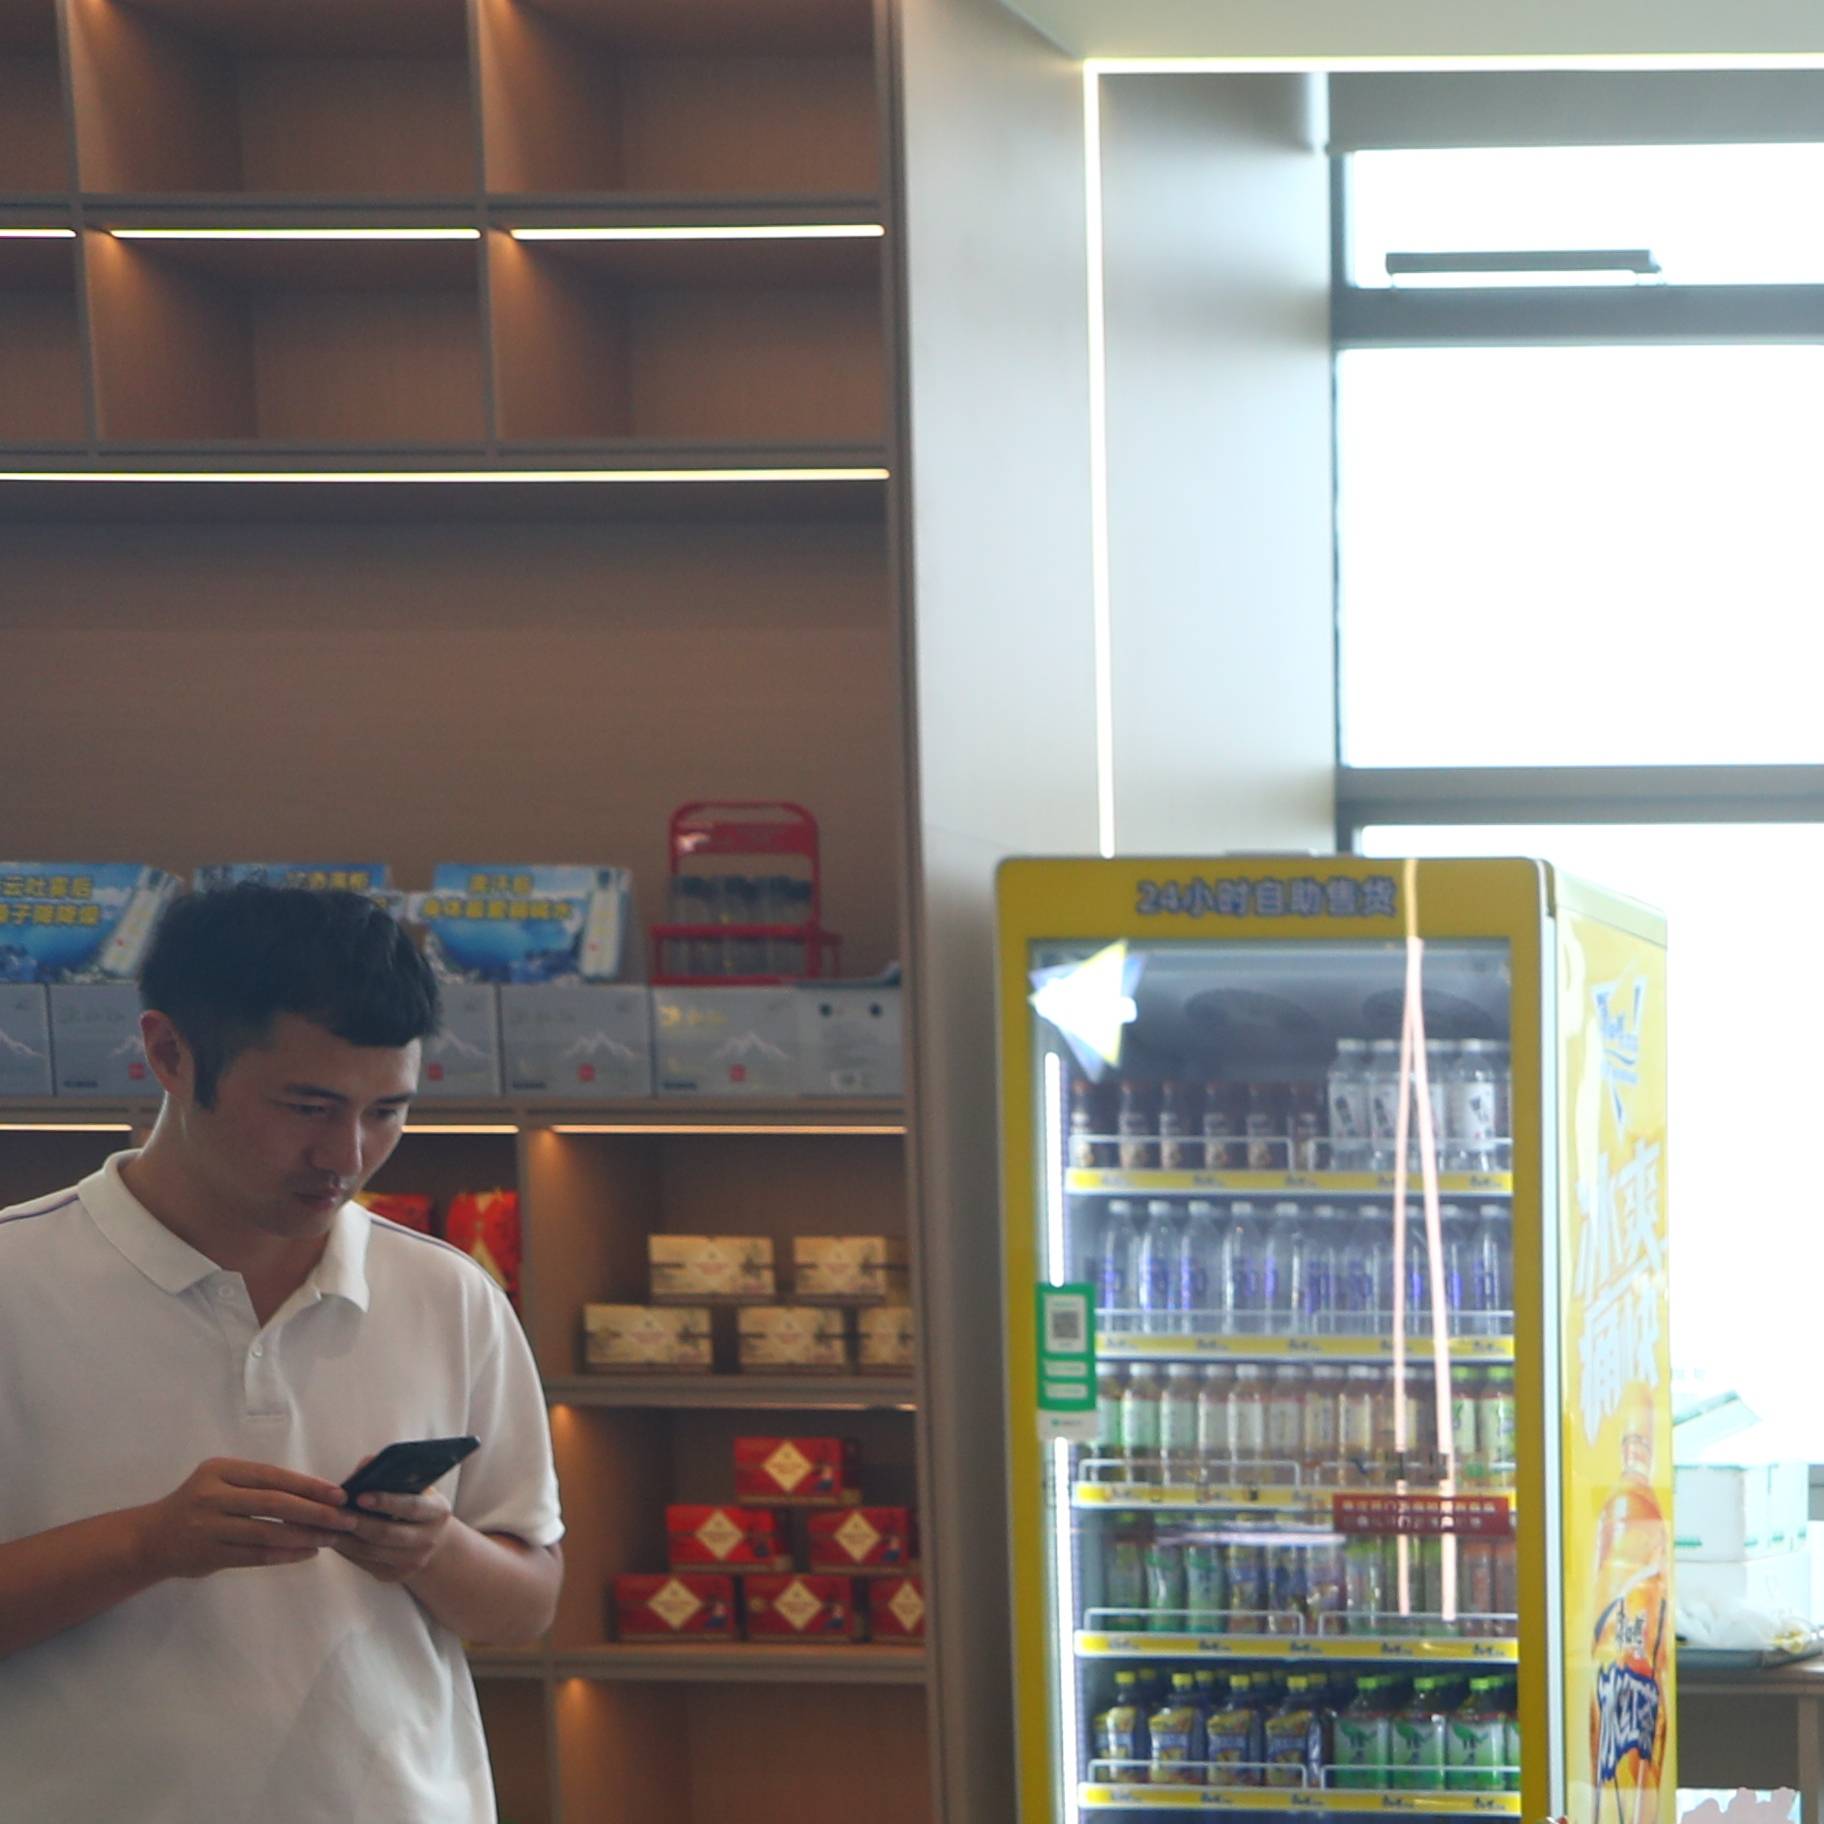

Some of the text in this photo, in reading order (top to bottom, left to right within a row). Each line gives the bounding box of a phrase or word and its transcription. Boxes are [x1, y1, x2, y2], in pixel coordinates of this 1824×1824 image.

[1137, 877, 1396, 917] 24小时自助售货
